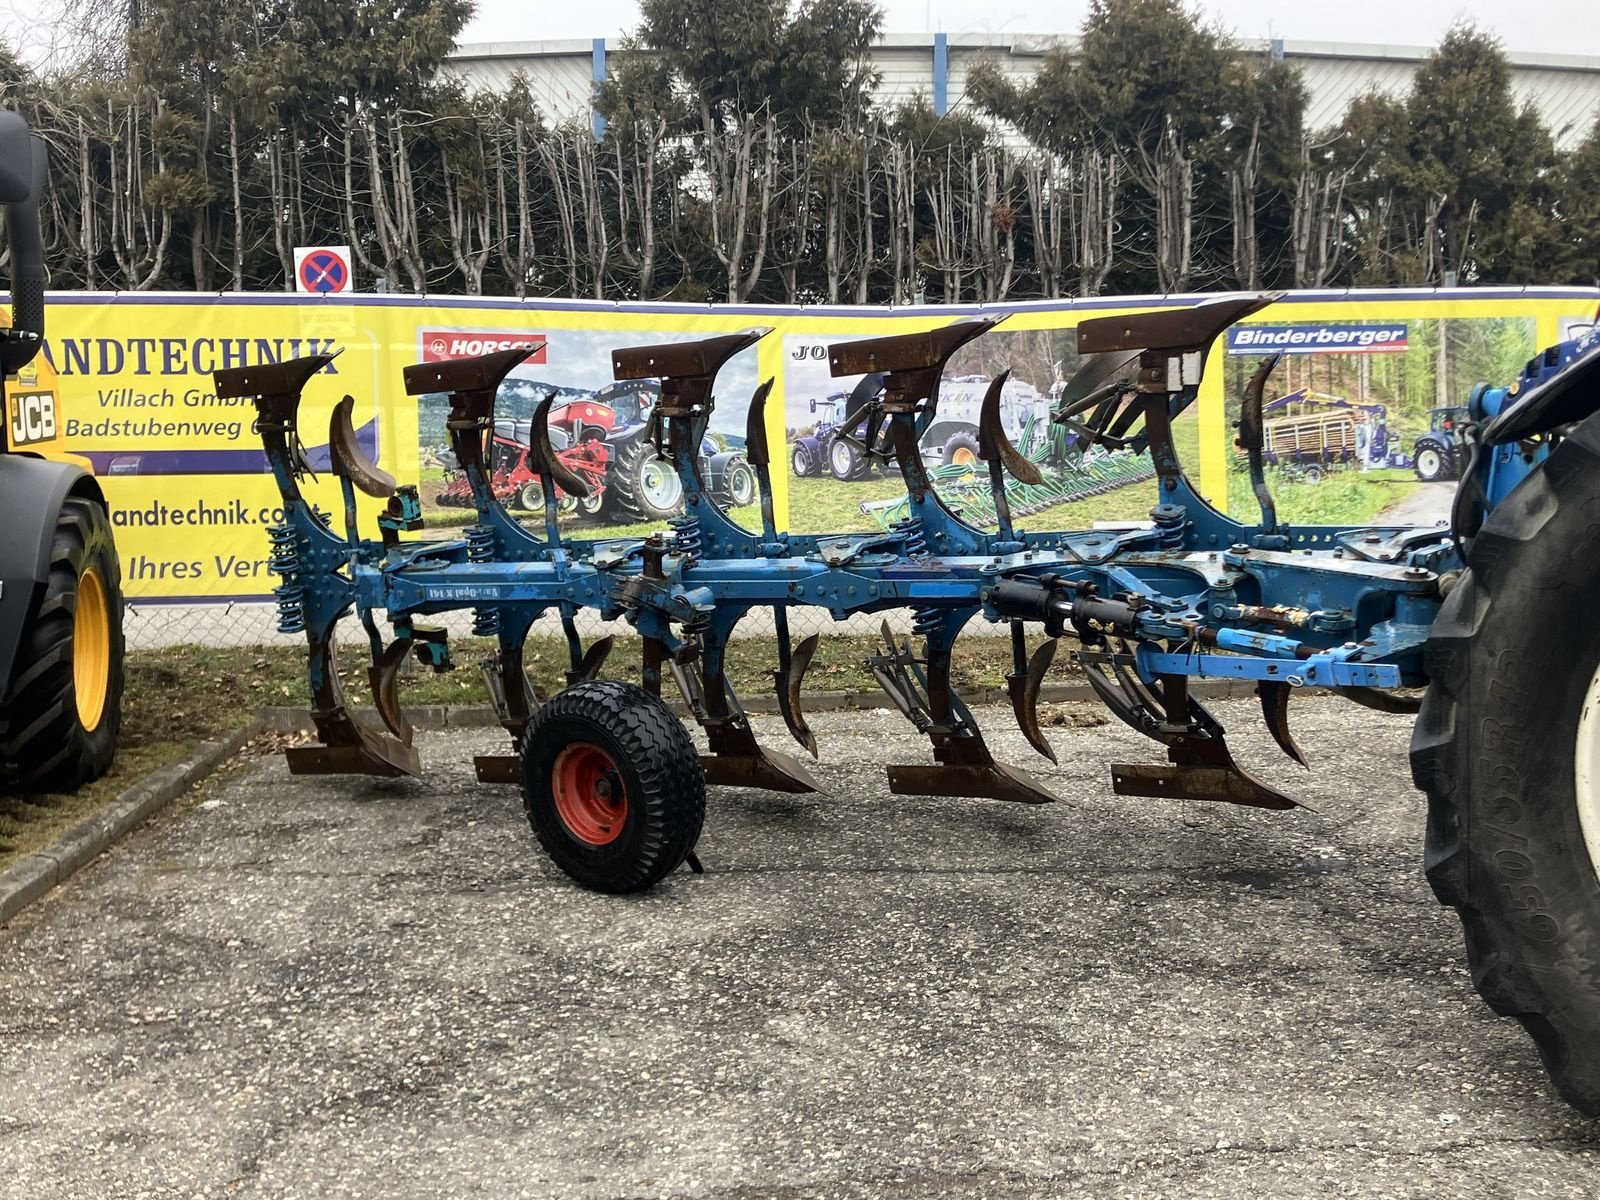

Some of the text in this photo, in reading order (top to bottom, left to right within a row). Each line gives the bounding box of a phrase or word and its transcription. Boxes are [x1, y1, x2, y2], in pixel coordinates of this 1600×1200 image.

[1234, 329, 1403, 345] Binderberger
[98, 388, 174, 407] Villach
[12, 396, 56, 442] JCB
[65, 418, 241, 440] Badstubenweg
[129, 555, 202, 580] Ihres
